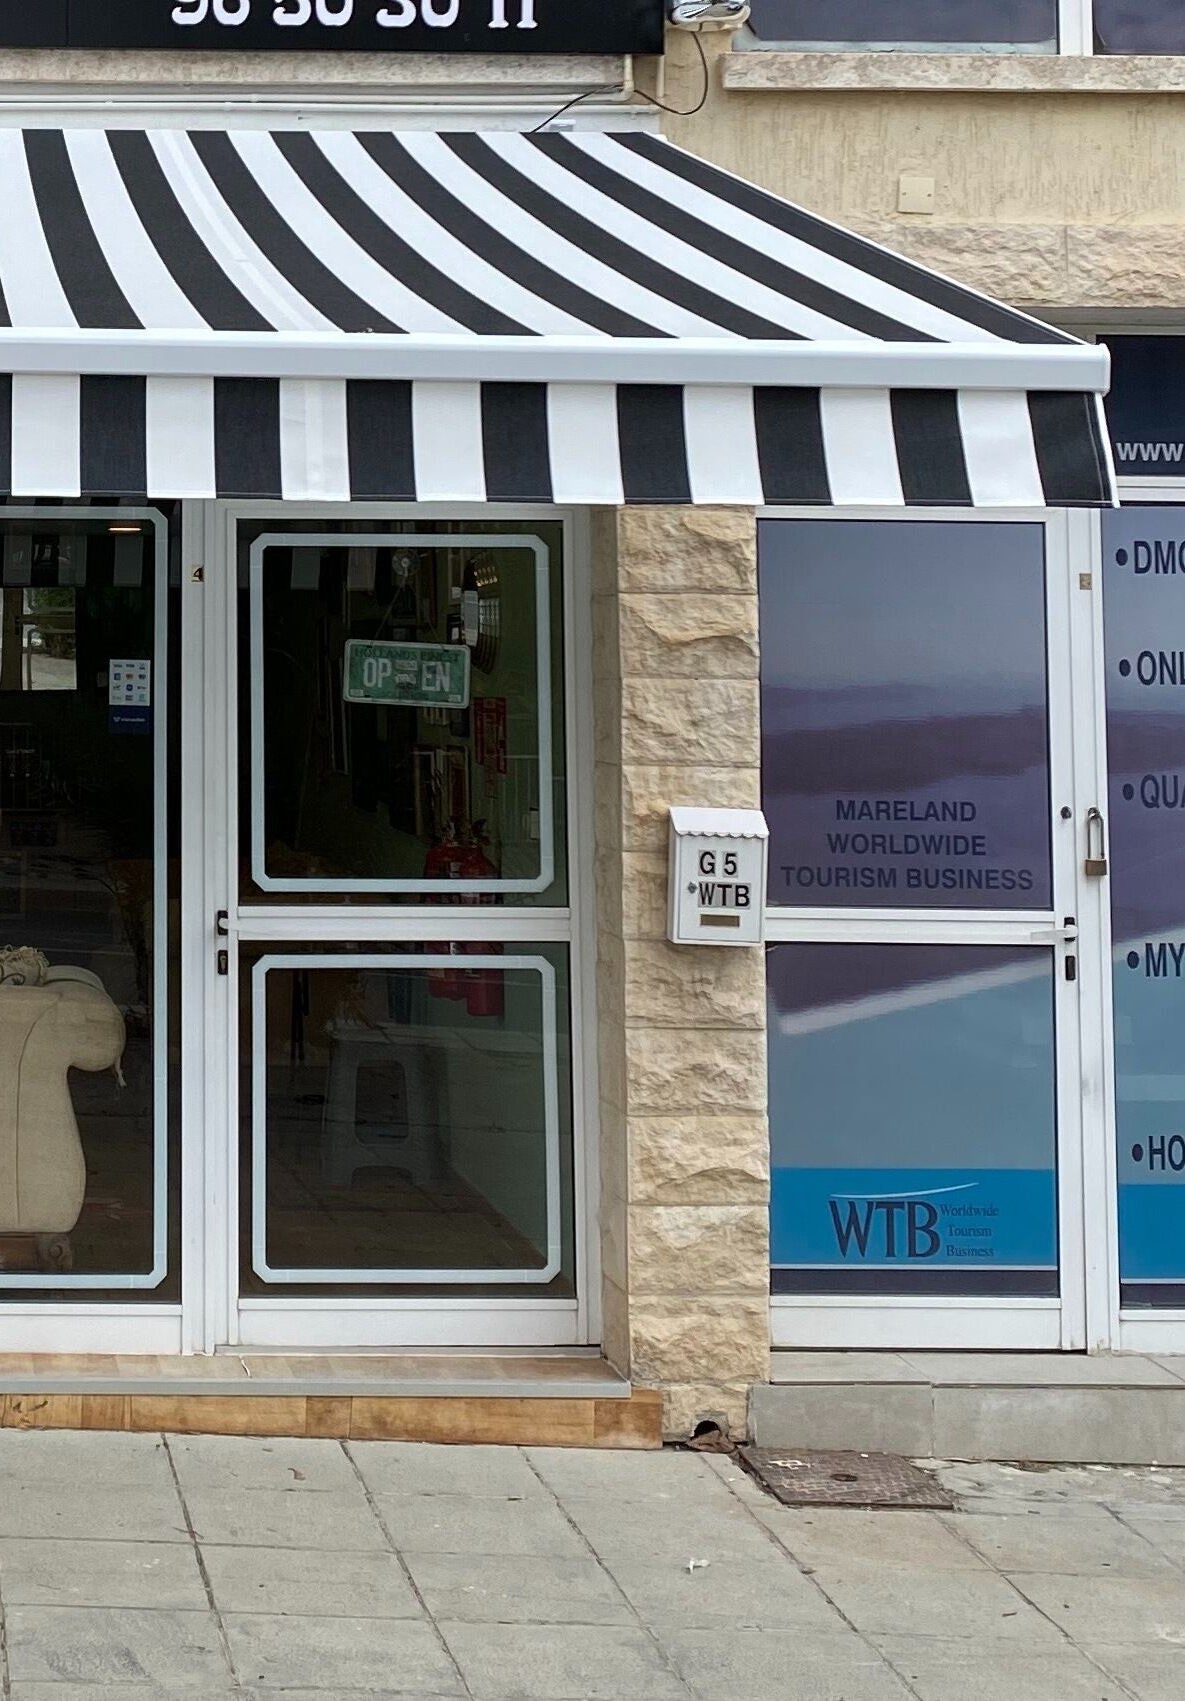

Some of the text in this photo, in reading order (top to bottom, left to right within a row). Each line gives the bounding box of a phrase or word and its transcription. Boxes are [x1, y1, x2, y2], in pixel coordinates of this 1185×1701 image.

[835, 799, 977, 822] MARELAND
[826, 833, 987, 856] WORLDWIDE
[780, 865, 1034, 891] TOURISM BUSINESS
[698, 882, 750, 907] WTB
[828, 1199, 1000, 1259] WTB Worldwide
[947, 1224, 992, 1238] Tourism
[946, 1244, 995, 1258] Business
